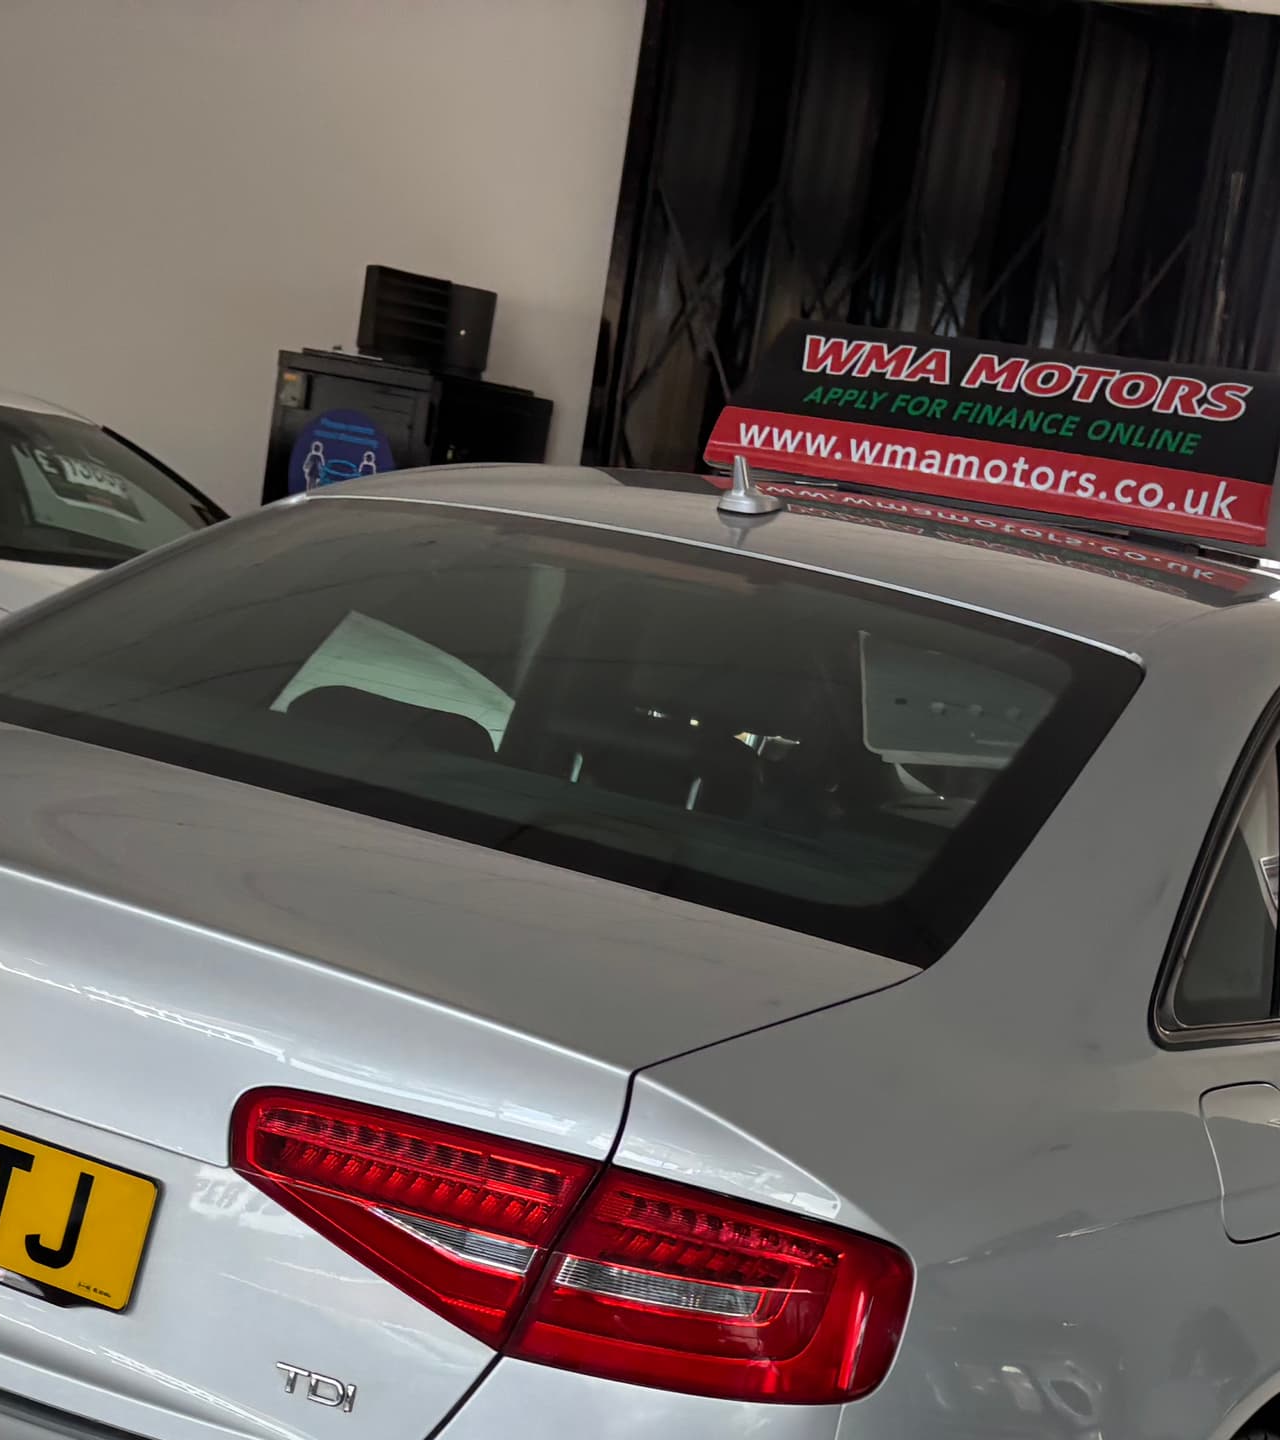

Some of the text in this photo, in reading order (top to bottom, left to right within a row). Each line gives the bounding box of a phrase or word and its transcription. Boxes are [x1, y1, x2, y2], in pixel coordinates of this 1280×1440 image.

[802, 334, 1254, 422] WMA MOTORS
[803, 386, 1202, 455] APPLY FOR FINANCE ONLINE
[738, 422, 1238, 521] www.wmamotors.co.uk
[276, 1361, 356, 1413] TDI
